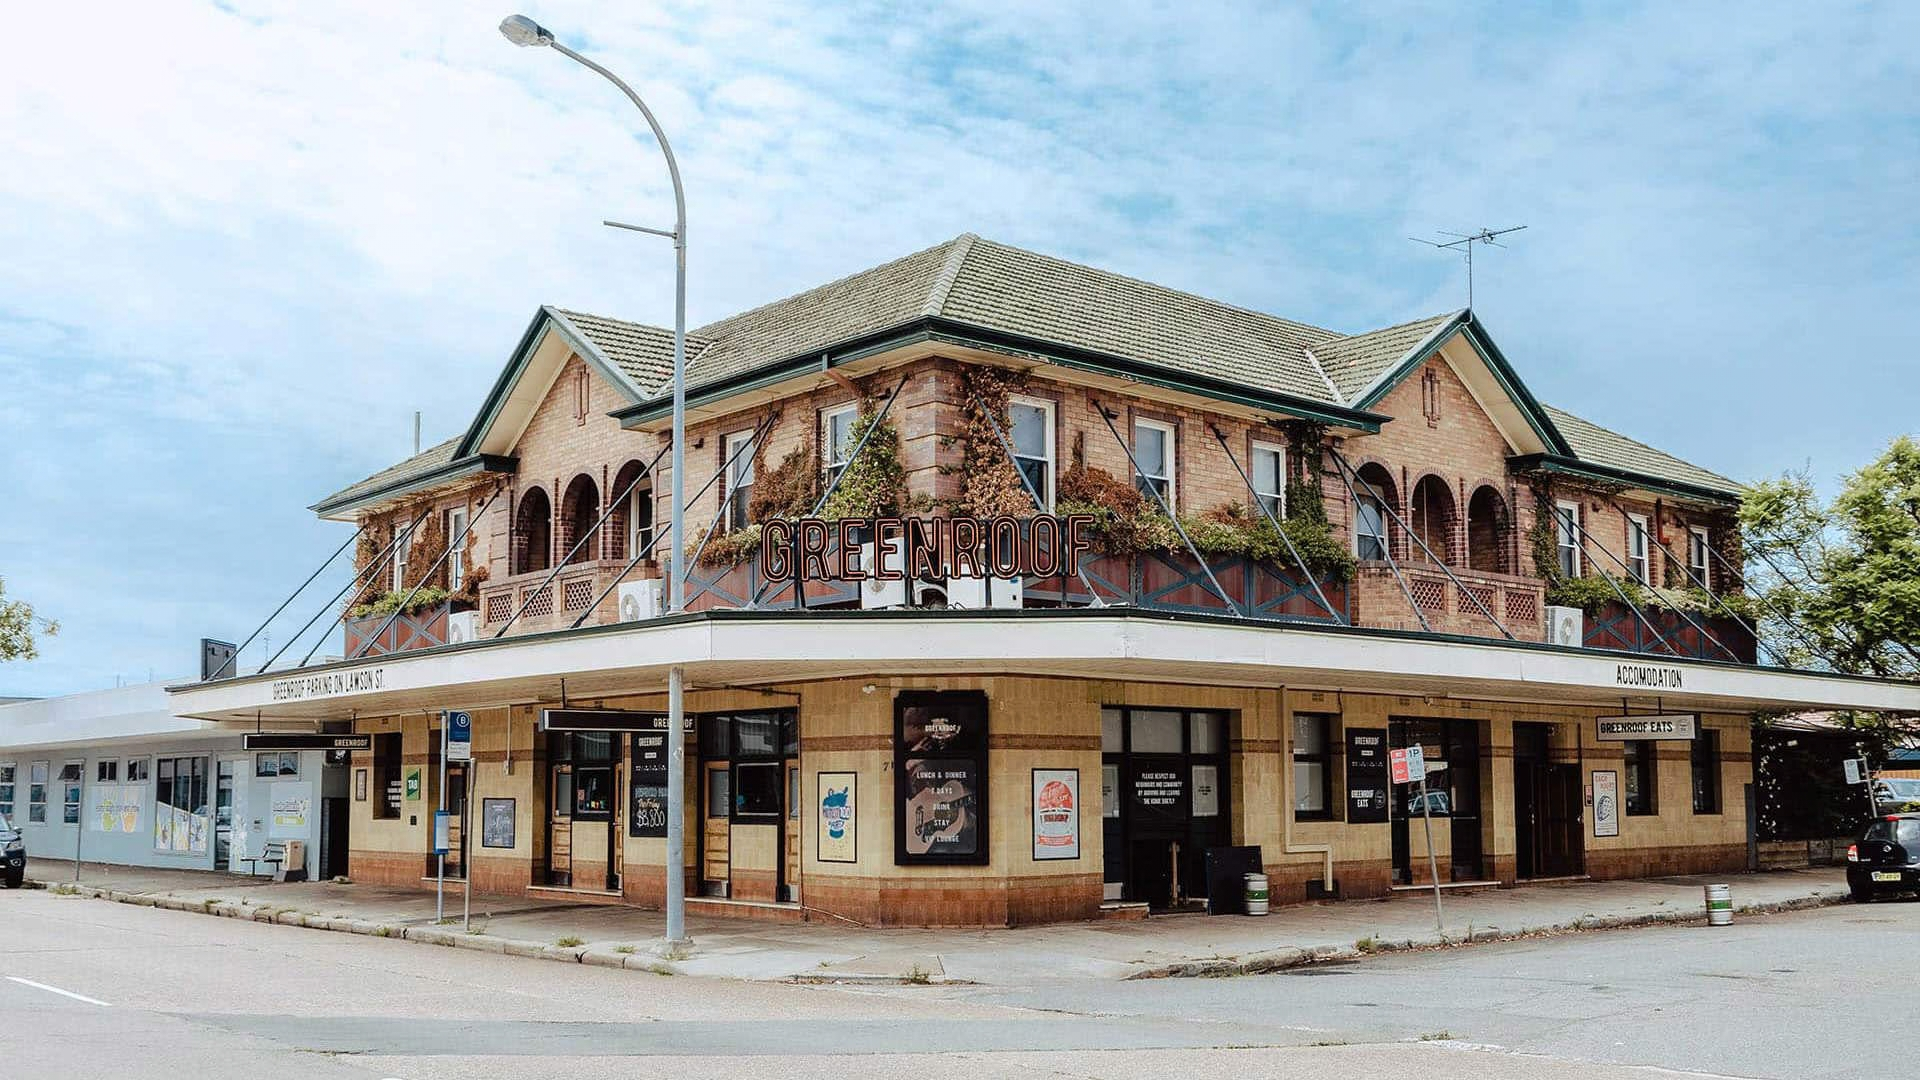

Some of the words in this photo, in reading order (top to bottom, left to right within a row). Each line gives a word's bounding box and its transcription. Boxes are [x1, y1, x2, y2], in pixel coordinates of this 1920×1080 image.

[760, 514, 1095, 582] GREENROOF
[1616, 664, 1682, 688] ACCOMODATION
[307, 677, 332, 697] PARKING
[335, 675, 344, 693] ON
[345, 671, 373, 692] LAWSON
[1600, 721, 1648, 734] GREENROOF
[1651, 721, 1673, 733] EATS
[916, 771, 936, 779] LUNCH
[945, 771, 967, 779] DINNER
[407, 779, 417, 790] TAB
[1357, 799, 1369, 808] EATS
[934, 819, 950, 827] STAY
